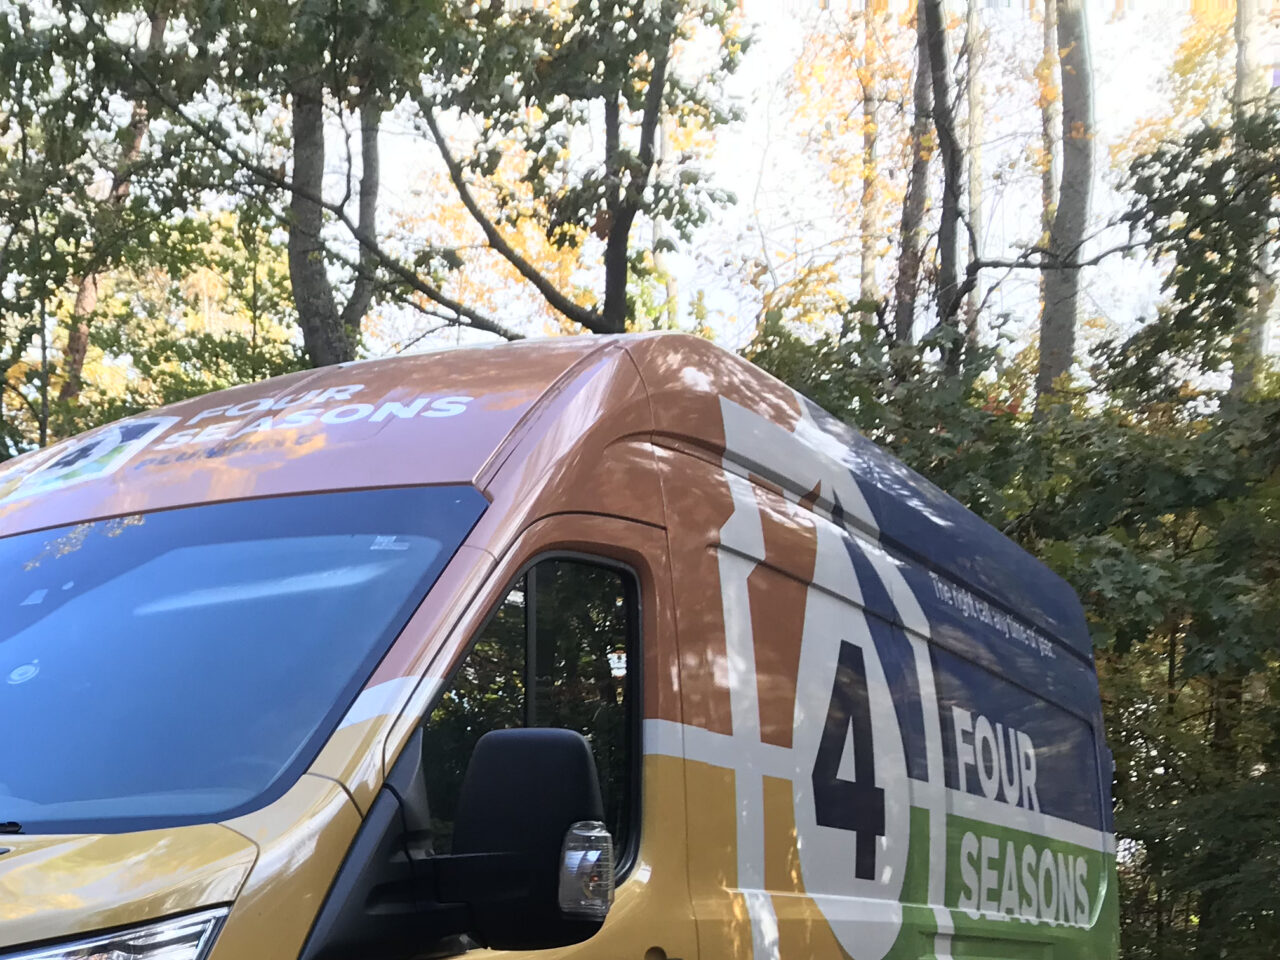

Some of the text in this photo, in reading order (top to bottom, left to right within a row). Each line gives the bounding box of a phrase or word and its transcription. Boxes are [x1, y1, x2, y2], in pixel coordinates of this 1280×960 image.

[152, 396, 474, 451] SEASONS
[185, 384, 365, 426] FOUR
[812, 639, 885, 880] 4
[952, 705, 1041, 813] FOUR
[957, 831, 1091, 926] SEASONS
